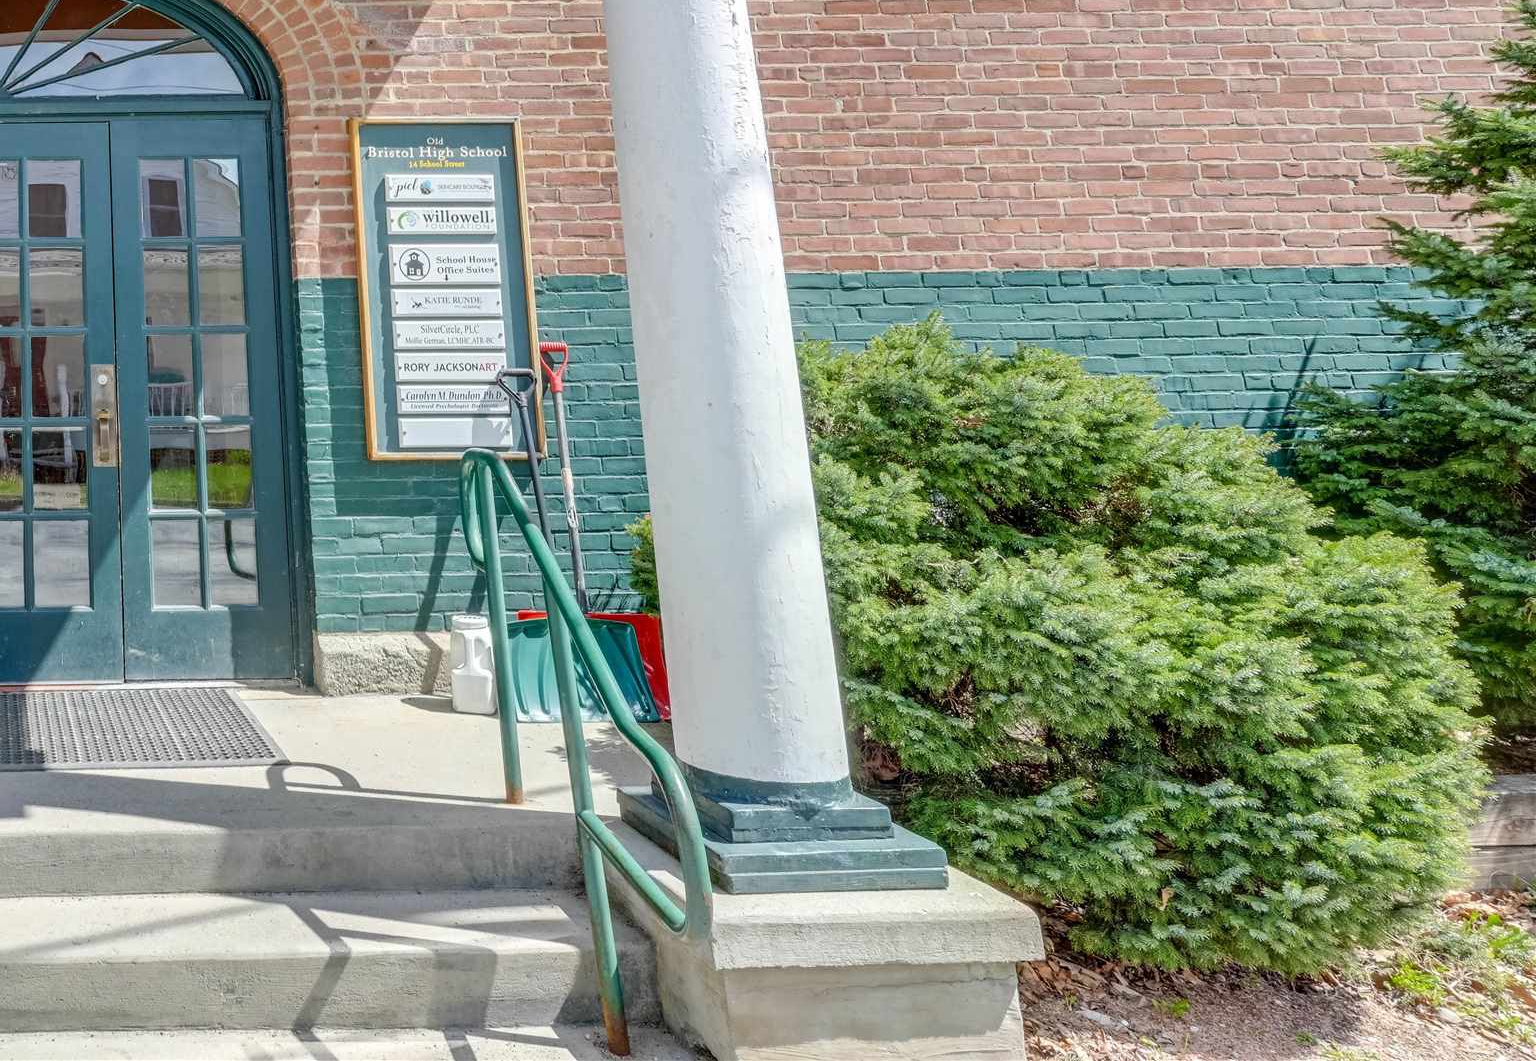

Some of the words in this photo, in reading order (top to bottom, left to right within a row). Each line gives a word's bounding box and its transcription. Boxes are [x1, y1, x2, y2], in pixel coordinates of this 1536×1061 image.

[426, 137, 444, 145] Old
[368, 148, 414, 157] Bristol
[419, 147, 454, 160] High
[460, 146, 507, 157] School
[422, 210, 489, 223] willowell
[436, 256, 467, 264] School
[469, 255, 496, 264] House
[437, 266, 464, 274] Office
[466, 265, 494, 274] Suites
[464, 324, 480, 334] PLC
[404, 363, 430, 372] RORY
[406, 391, 437, 401] Carolyn
